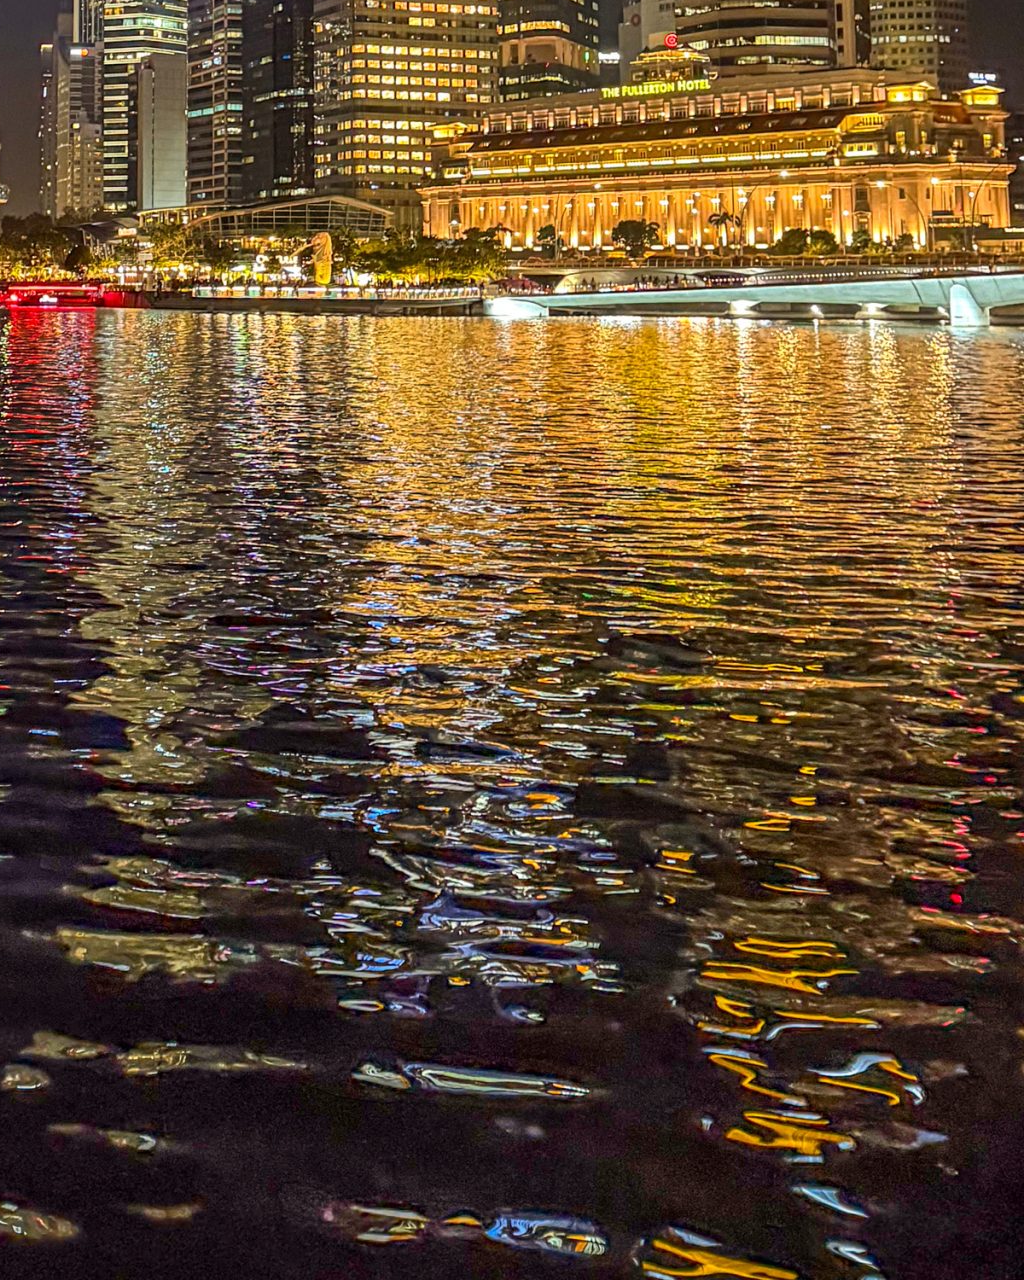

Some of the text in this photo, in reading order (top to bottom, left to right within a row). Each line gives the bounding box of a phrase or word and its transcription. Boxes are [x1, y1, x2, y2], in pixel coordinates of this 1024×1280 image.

[601, 79, 711, 98] THE FULLERTON HOTEL
